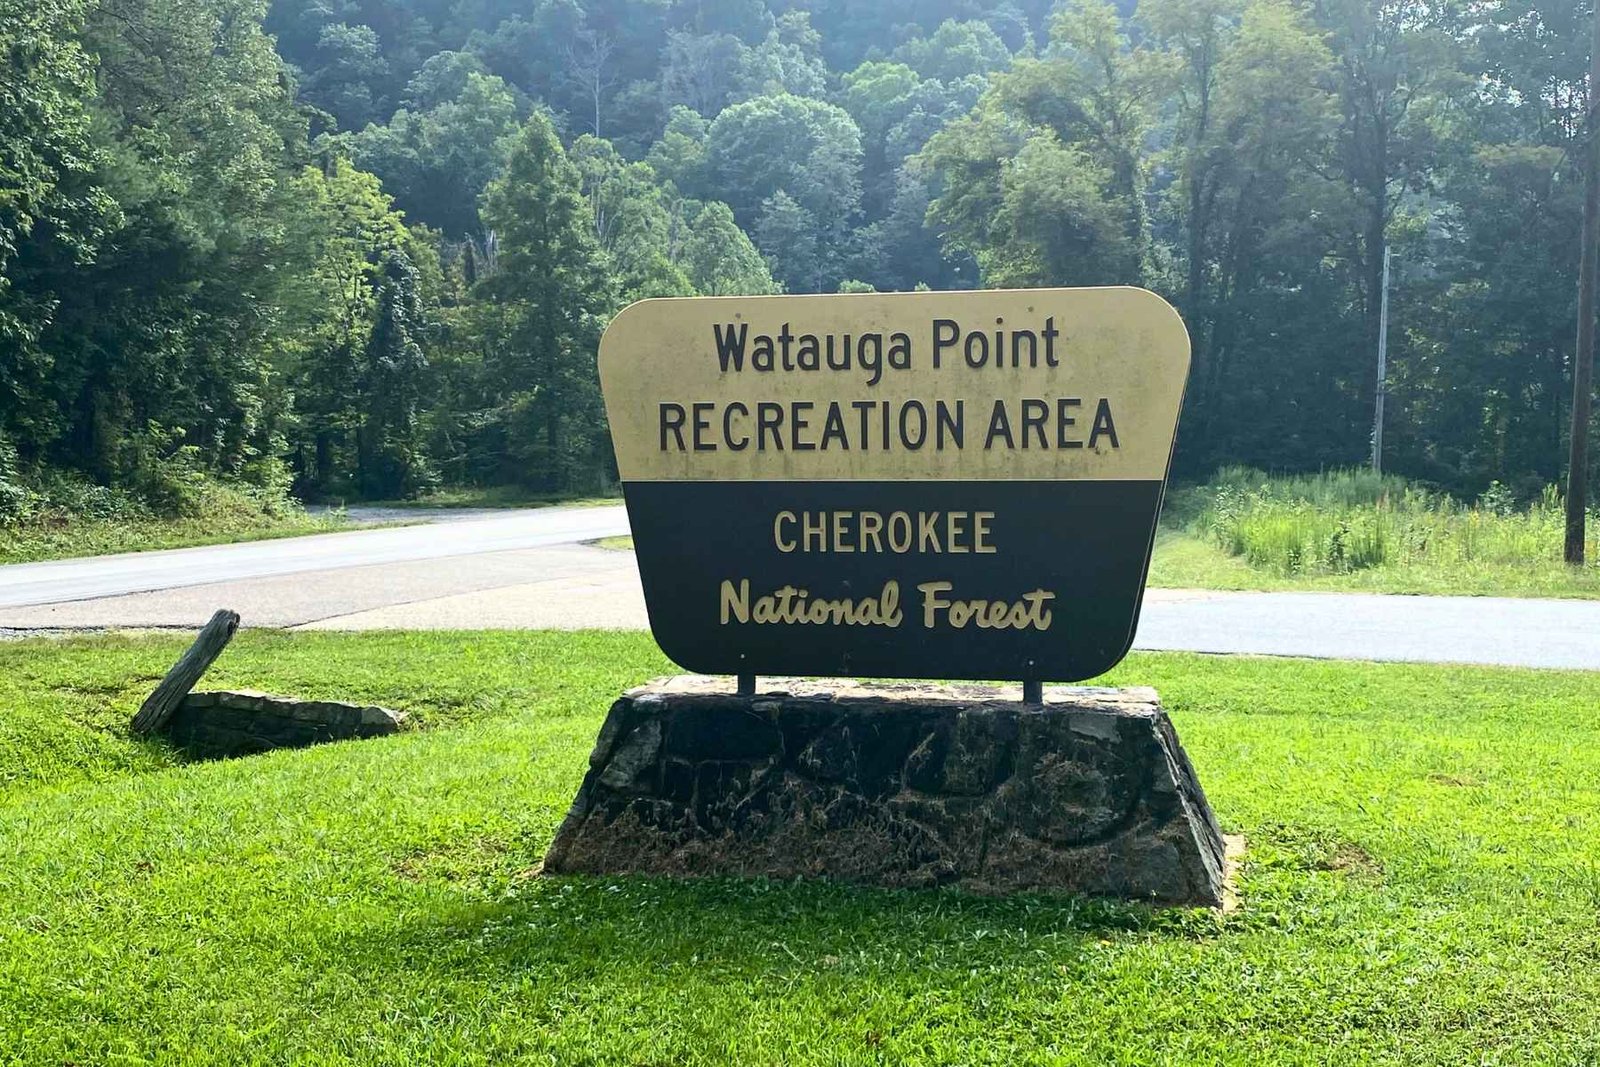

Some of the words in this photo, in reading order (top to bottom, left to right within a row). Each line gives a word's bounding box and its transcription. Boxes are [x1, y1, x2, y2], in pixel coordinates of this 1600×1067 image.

[713, 322, 912, 386] Watauga
[932, 316, 1060, 369] Point
[659, 400, 965, 452] RECREATION
[984, 398, 1121, 450] AREA
[774, 511, 997, 554] CHEROKEE
[719, 579, 903, 628] National
[917, 581, 1056, 632] Forest
